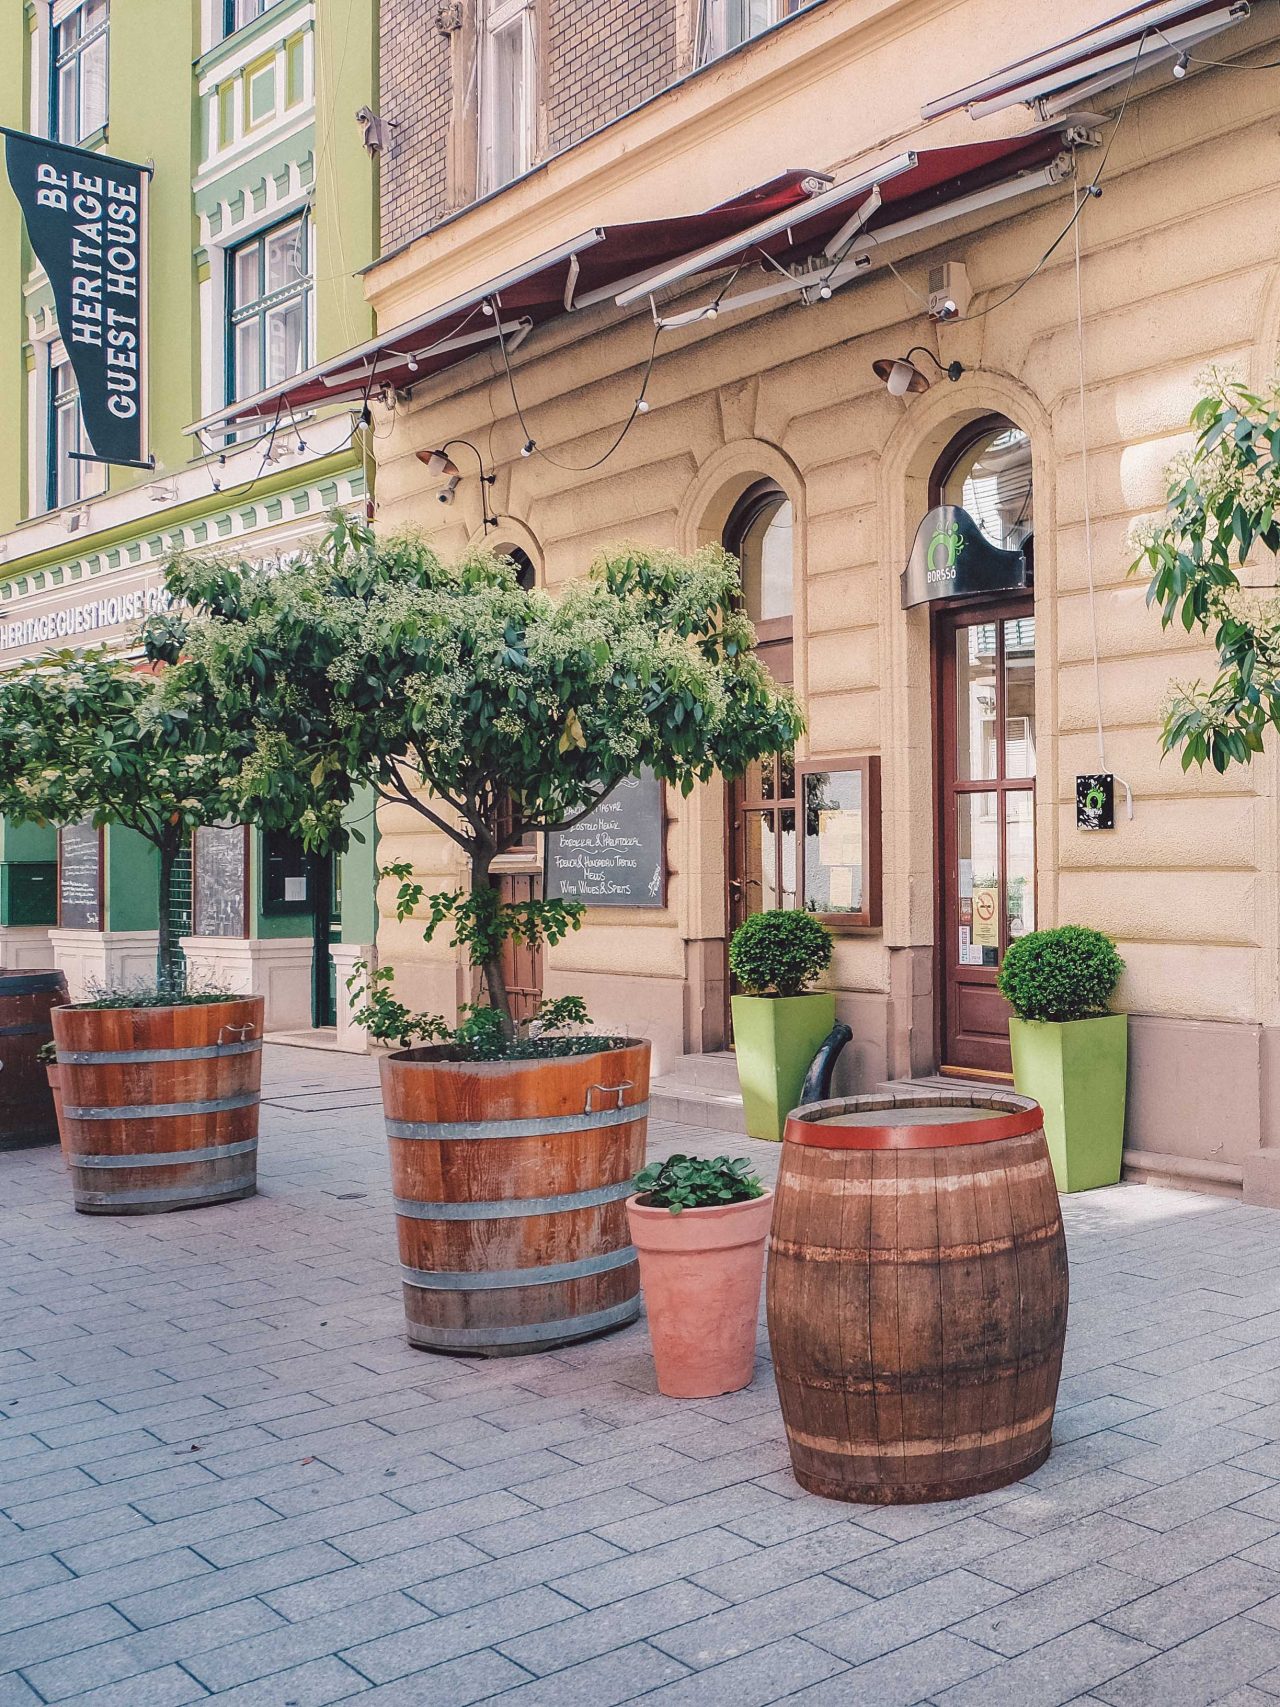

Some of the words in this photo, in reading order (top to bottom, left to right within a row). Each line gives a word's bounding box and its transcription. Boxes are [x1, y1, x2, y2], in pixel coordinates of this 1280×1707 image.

[37, 163, 68, 212] BP.
[107, 179, 136, 297] HOUSE
[72, 170, 102, 347] HERITAGE
[107, 308, 136, 419] GUEST
[927, 566, 956, 583] BORSSÓ
